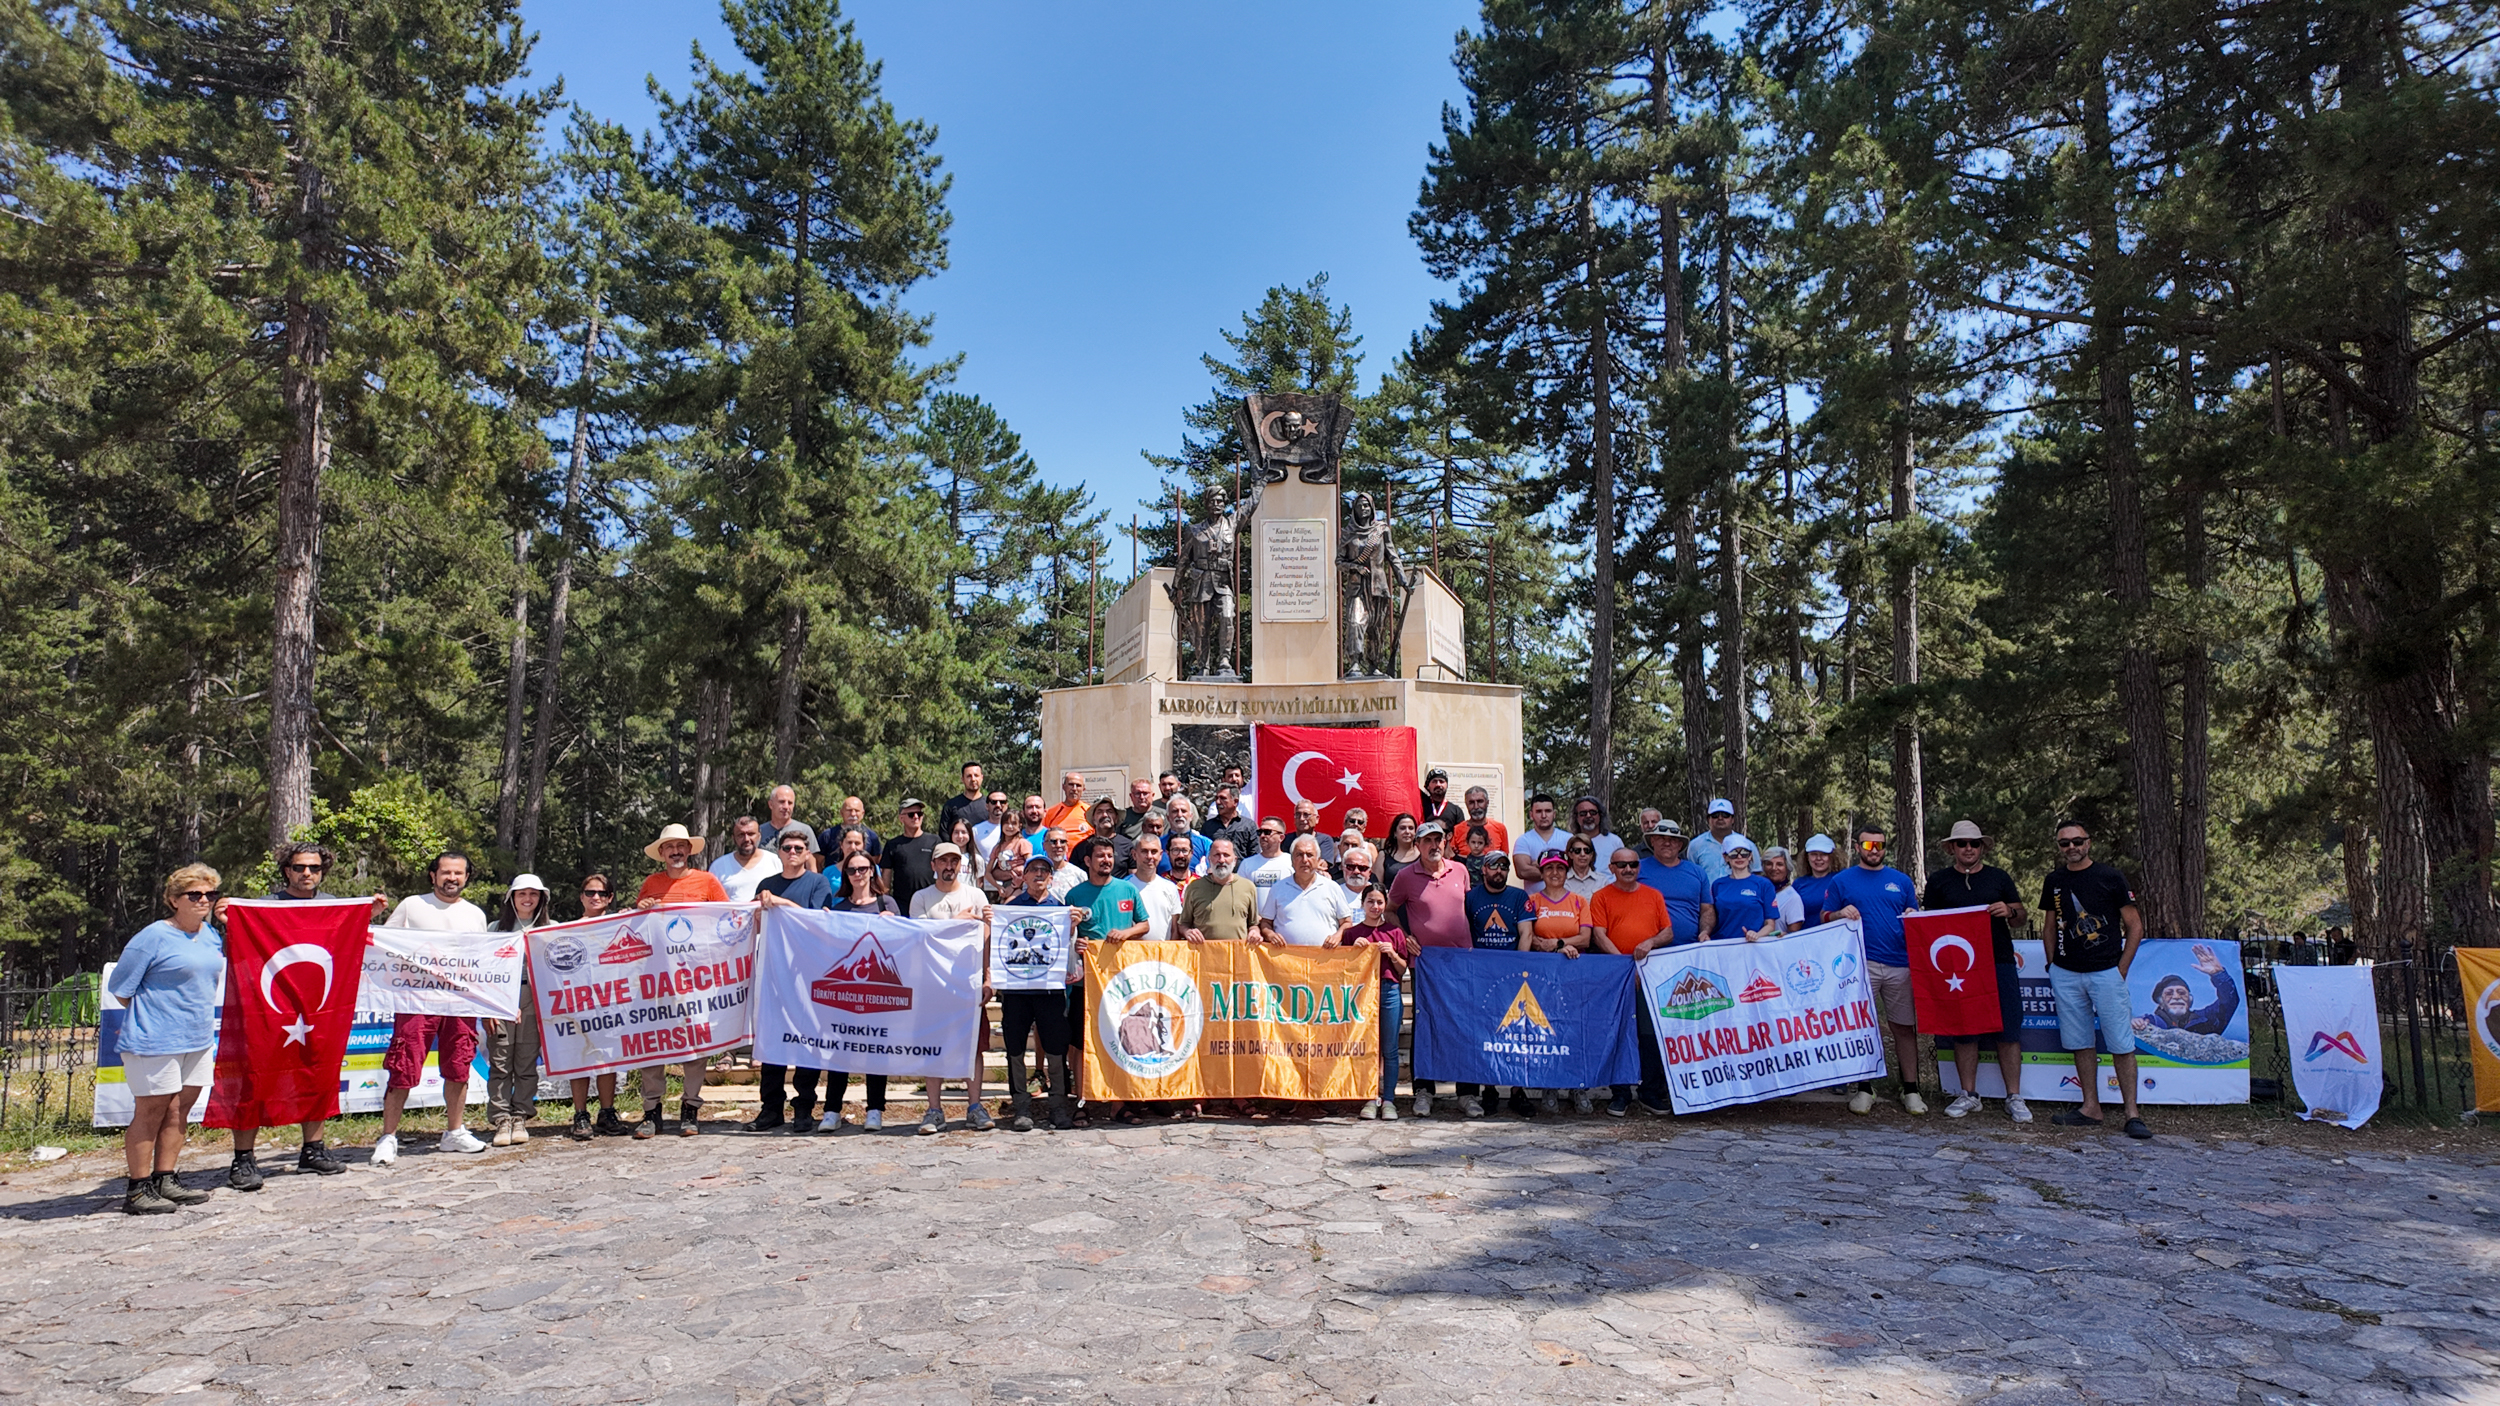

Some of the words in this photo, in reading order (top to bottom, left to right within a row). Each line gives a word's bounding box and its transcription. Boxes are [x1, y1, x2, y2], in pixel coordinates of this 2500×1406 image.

[1158, 695, 1237, 715] KARBOĞAZI
[1302, 695, 1359, 715] MİLLİYE
[1361, 696, 1398, 712] ANITI
[666, 943, 696, 955] UIAA
[362, 959, 387, 972] OĞA
[460, 971, 511, 984] KULÜBÜ
[419, 954, 479, 969] DAĞCILIK
[1107, 973, 1196, 1005] MERDAK
[1837, 975, 1859, 990] UIAA
[548, 978, 633, 1017] ZİRVE
[813, 988, 836, 1001] TÜRKİYE
[837, 991, 865, 1004] DAĞCILIK
[865, 993, 909, 1007] FEDERASYONU
[1210, 981, 1365, 1026] MERDAK
[1671, 986, 1722, 1006] BOLKARLAR
[554, 1020, 576, 1037] VE
[580, 1010, 625, 1034] DOĞA
[629, 999, 703, 1025] SPORLARI
[707, 986, 749, 1012] KULÜ
[831, 1022, 889, 1038] TÜRKİYE
[1665, 1021, 1774, 1066] BOLKARLAR
[1776, 1000, 1875, 1045] DAĞCILIK
[2036, 1019, 2057, 1027] ANMA
[620, 1017, 713, 1058] MERSİN
[782, 1033, 840, 1051] DAĞCILIK
[843, 1041, 942, 1057] FEDERASYONU
[1210, 1036, 1245, 1056] MERSİN
[1249, 1036, 1294, 1058] DAĞCILIK
[1296, 1041, 1323, 1058] SPOR
[1483, 1041, 1570, 1056] ROTASIZLAR
[1679, 1072, 1700, 1091] VE
[1701, 1061, 1736, 1087] DOĞA
[1738, 1050, 1811, 1081] SPORLARI
[1817, 1034, 1875, 1064] KULÜBÜ
